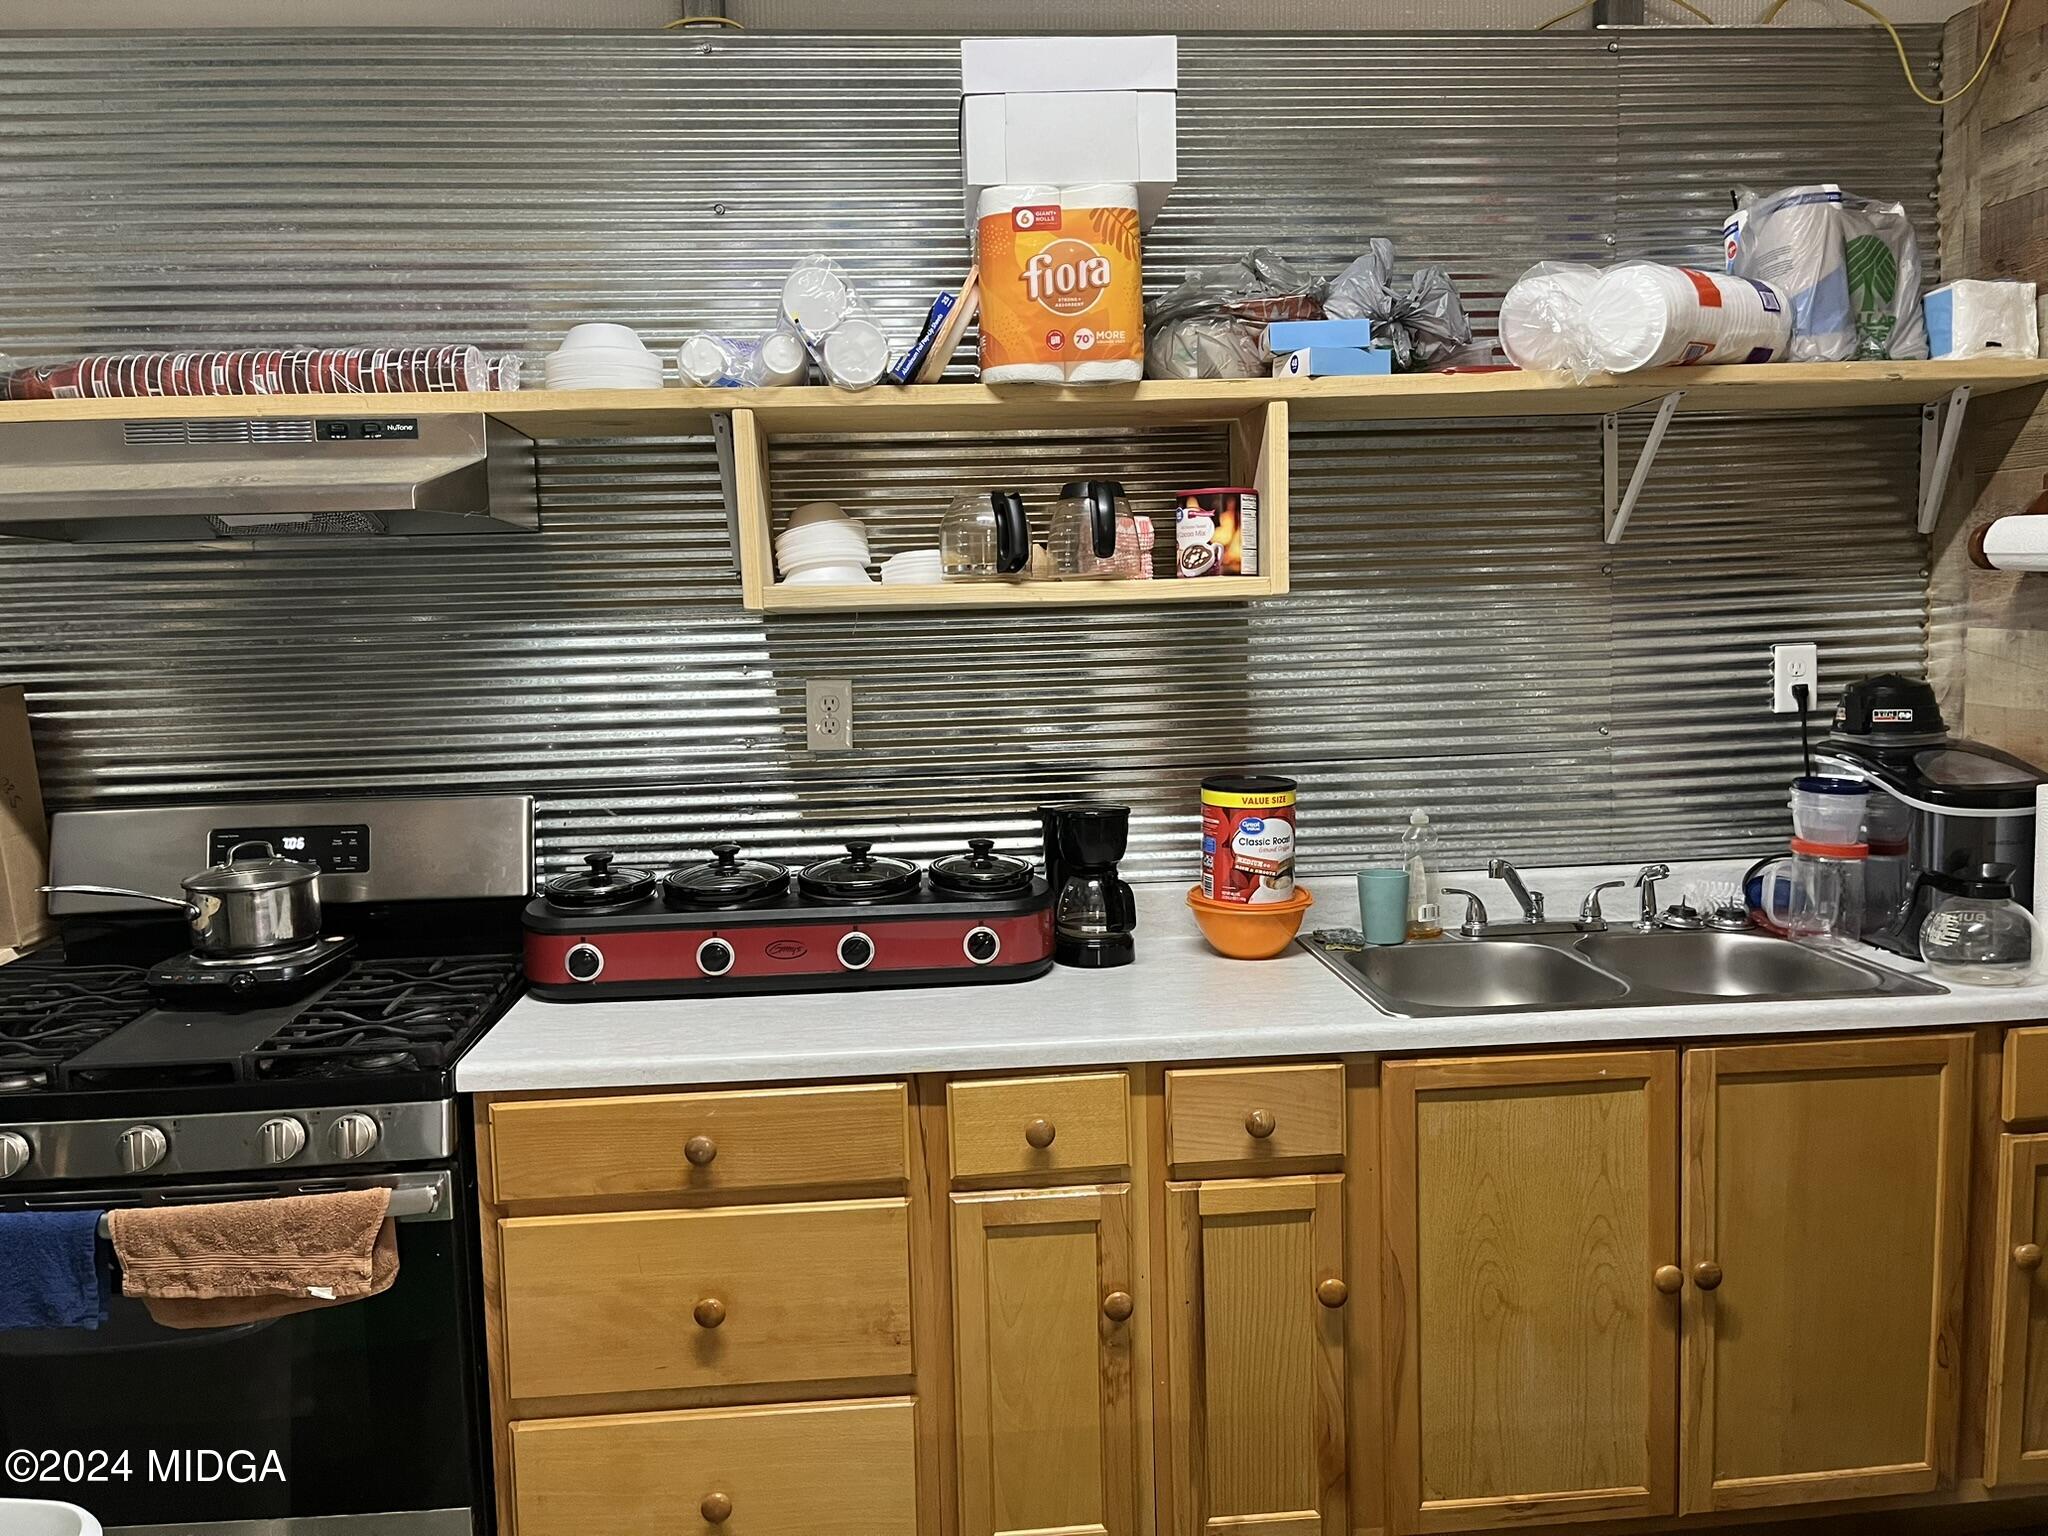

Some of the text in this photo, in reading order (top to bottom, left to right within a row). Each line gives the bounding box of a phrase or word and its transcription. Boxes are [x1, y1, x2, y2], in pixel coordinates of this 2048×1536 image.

[1020, 213, 1030, 225] 6
[1022, 253, 1111, 299] fiora
[1096, 330, 1126, 340] MORE
[901, 351, 919, 376] Aluminum
[931, 313, 944, 328] Sheets
[1241, 795, 1287, 805] VALUE SIZE
[1238, 837, 1271, 846] Classic
